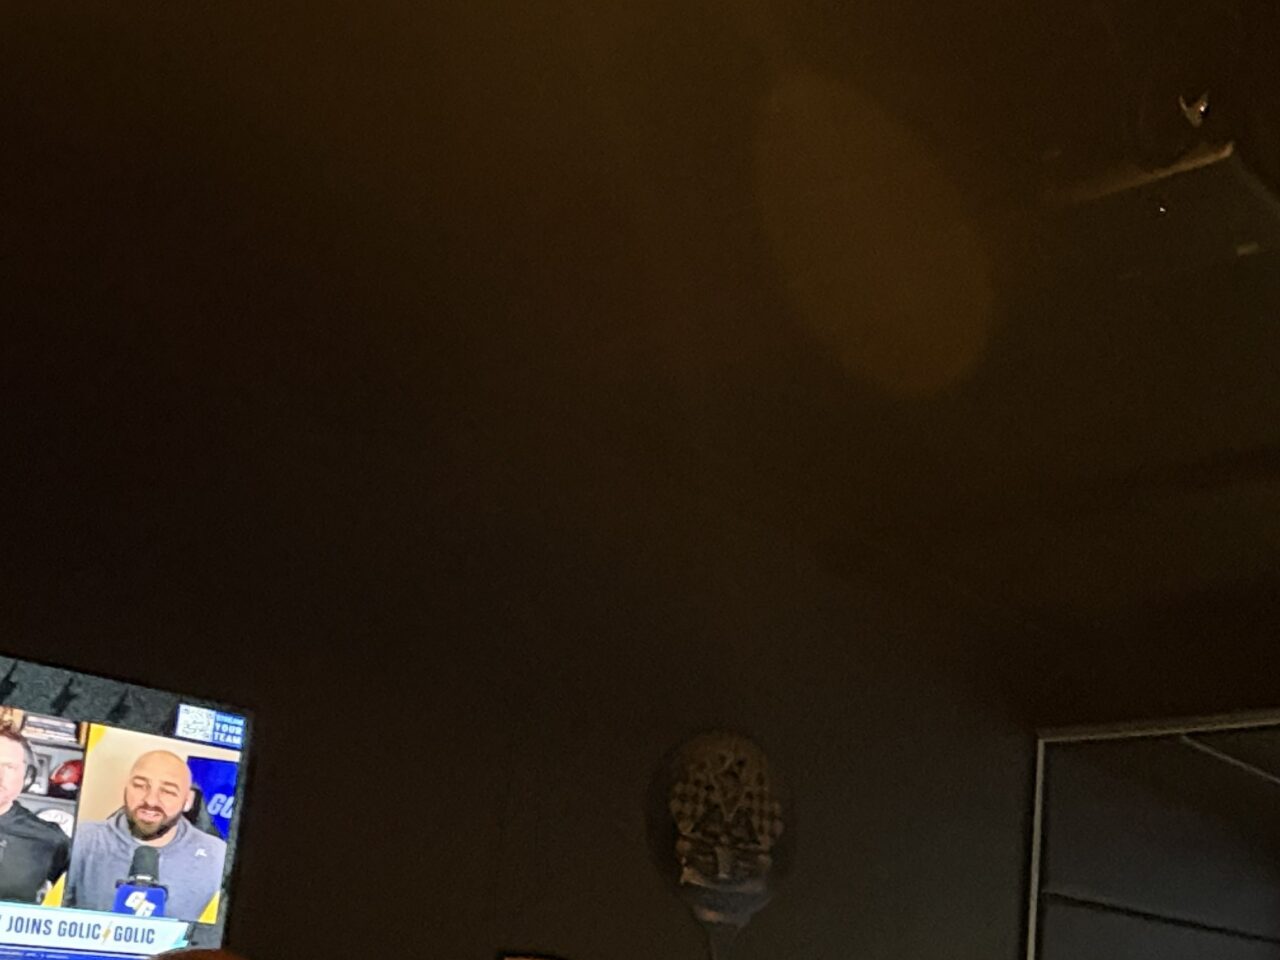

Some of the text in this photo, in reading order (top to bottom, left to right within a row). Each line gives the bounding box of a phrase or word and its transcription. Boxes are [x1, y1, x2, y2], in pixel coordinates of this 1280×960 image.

[213, 732, 241, 744] TEAM
[6, 916, 53, 936] JOINS
[58, 921, 102, 940] GOLIC
[114, 926, 156, 944] GOLIC
